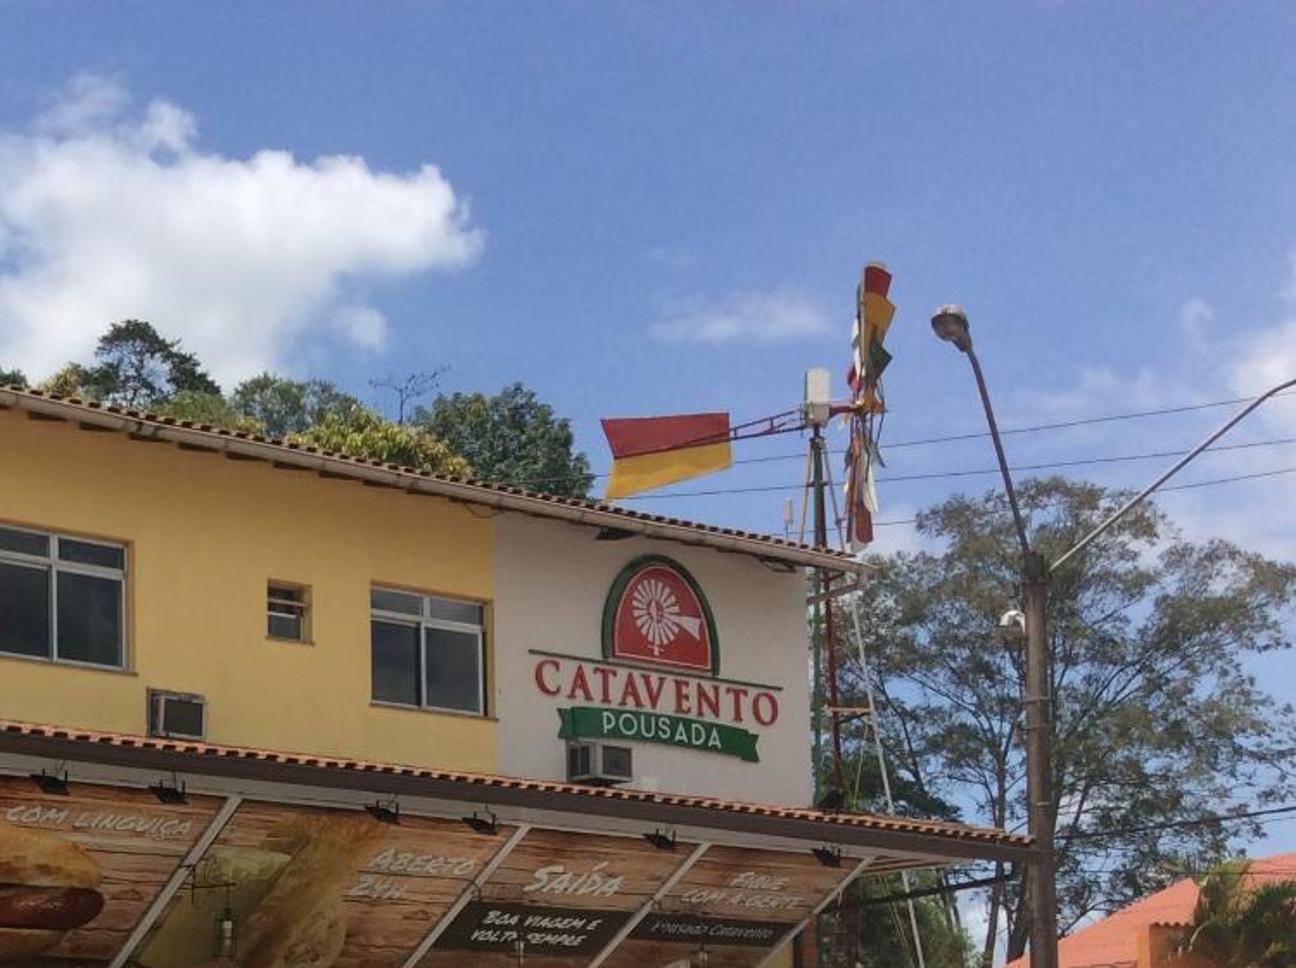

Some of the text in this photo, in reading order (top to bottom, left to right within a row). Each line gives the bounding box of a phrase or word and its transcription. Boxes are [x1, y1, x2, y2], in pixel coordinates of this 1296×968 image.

[535, 659, 778, 726] CATAVENTO
[603, 711, 722, 749] POUSADA
[6, 805, 70, 824] COM
[367, 849, 477, 876] ABERTO
[523, 861, 626, 897] SAÍDA
[482, 909, 521, 926] BOA
[523, 914, 586, 930] VIAGEM
